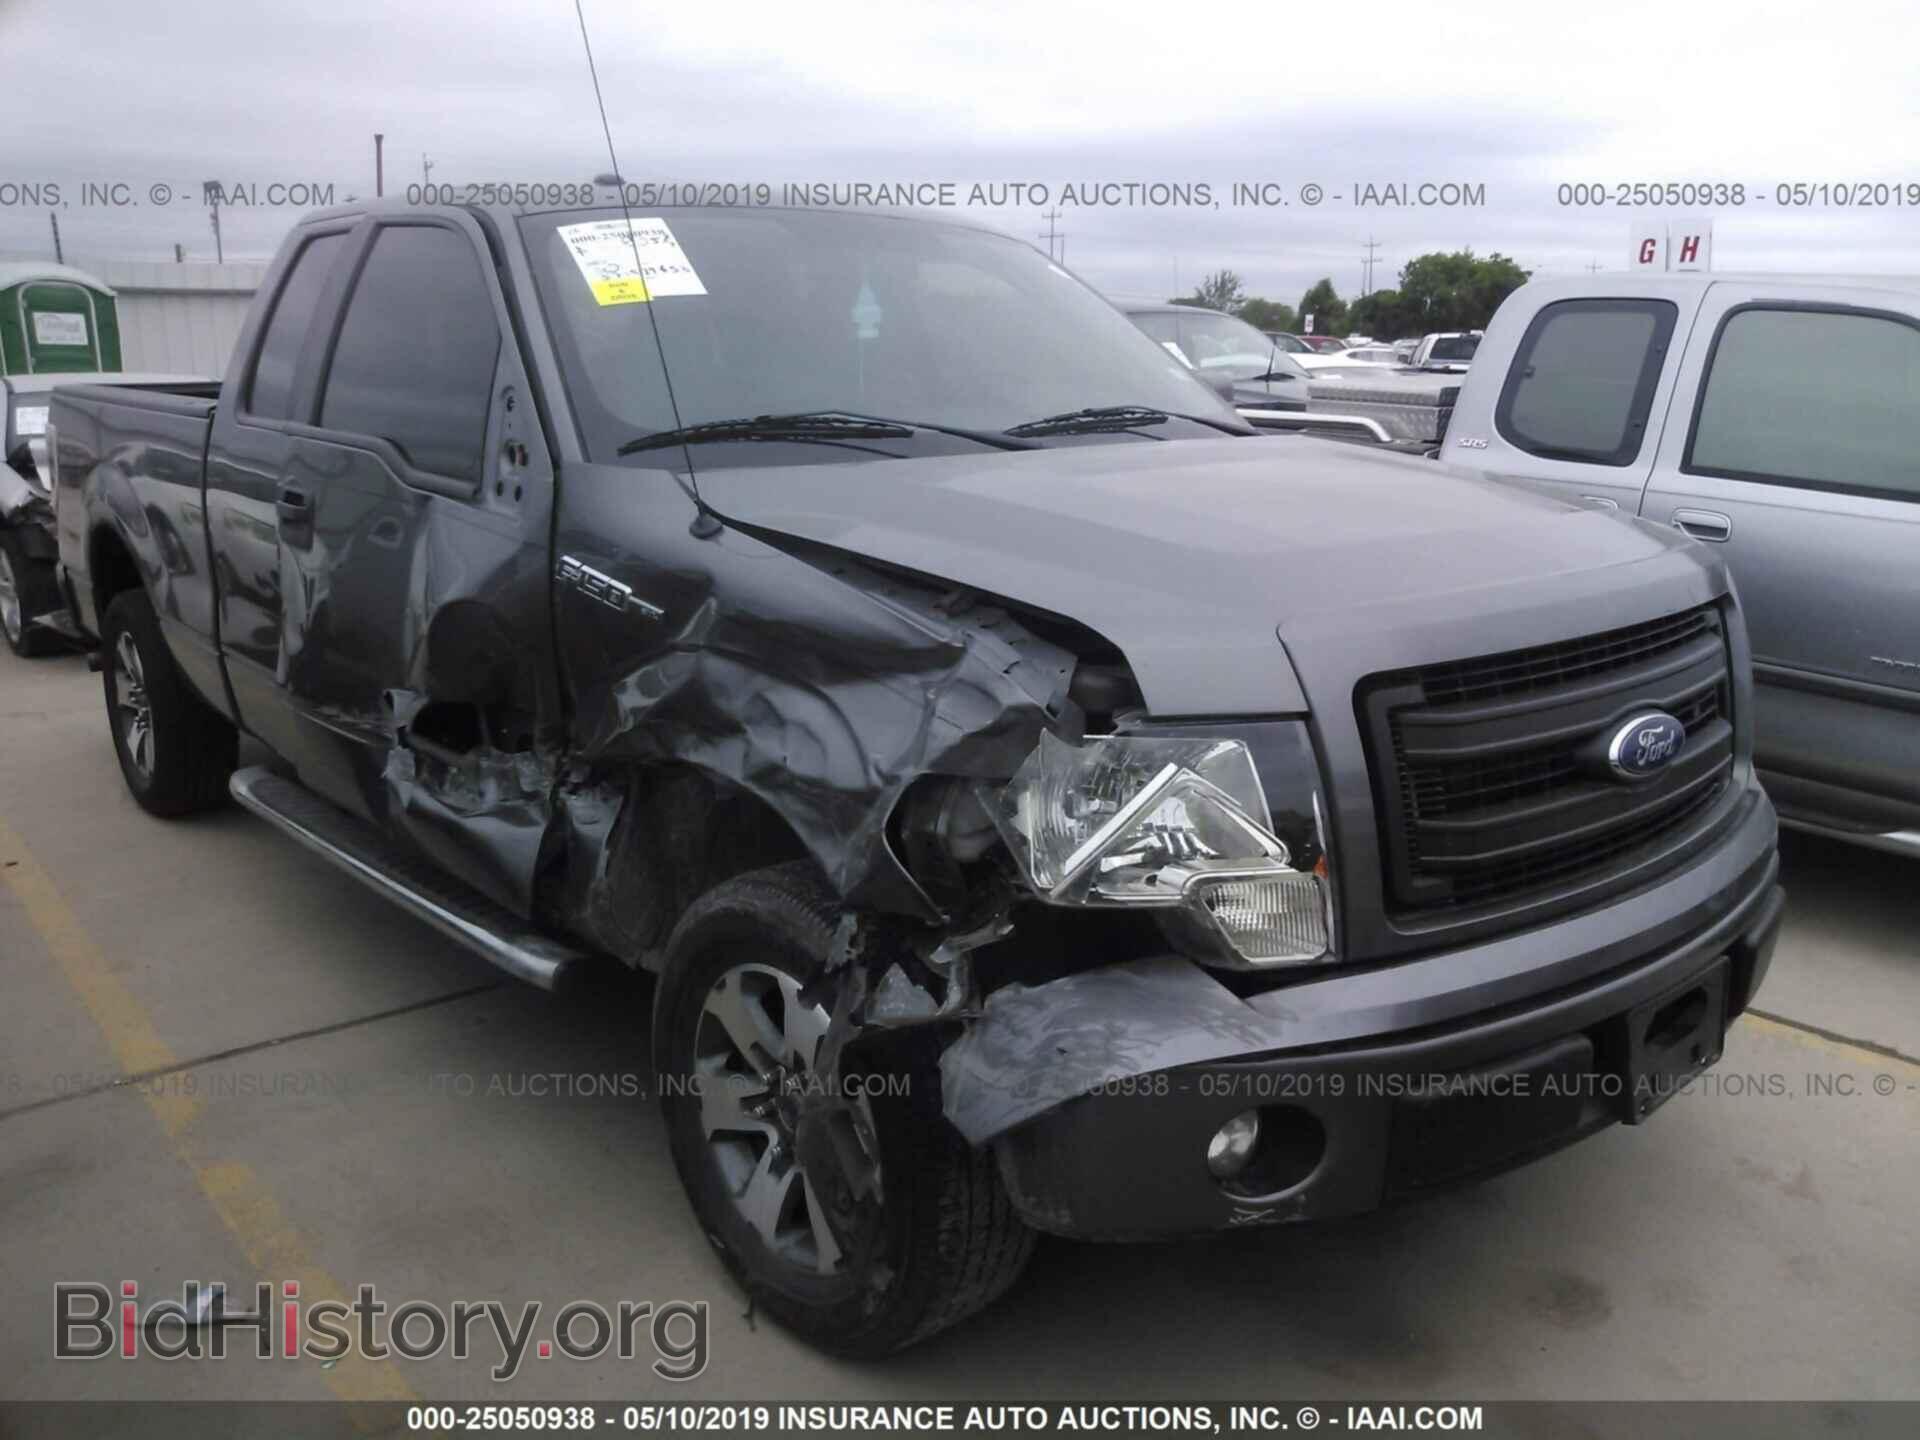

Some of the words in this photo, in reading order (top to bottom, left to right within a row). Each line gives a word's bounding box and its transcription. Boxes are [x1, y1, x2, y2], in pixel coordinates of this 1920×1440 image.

[1638, 238, 1656, 265] G
[1679, 236, 1701, 264] H
[1636, 725, 1676, 766] Ford
